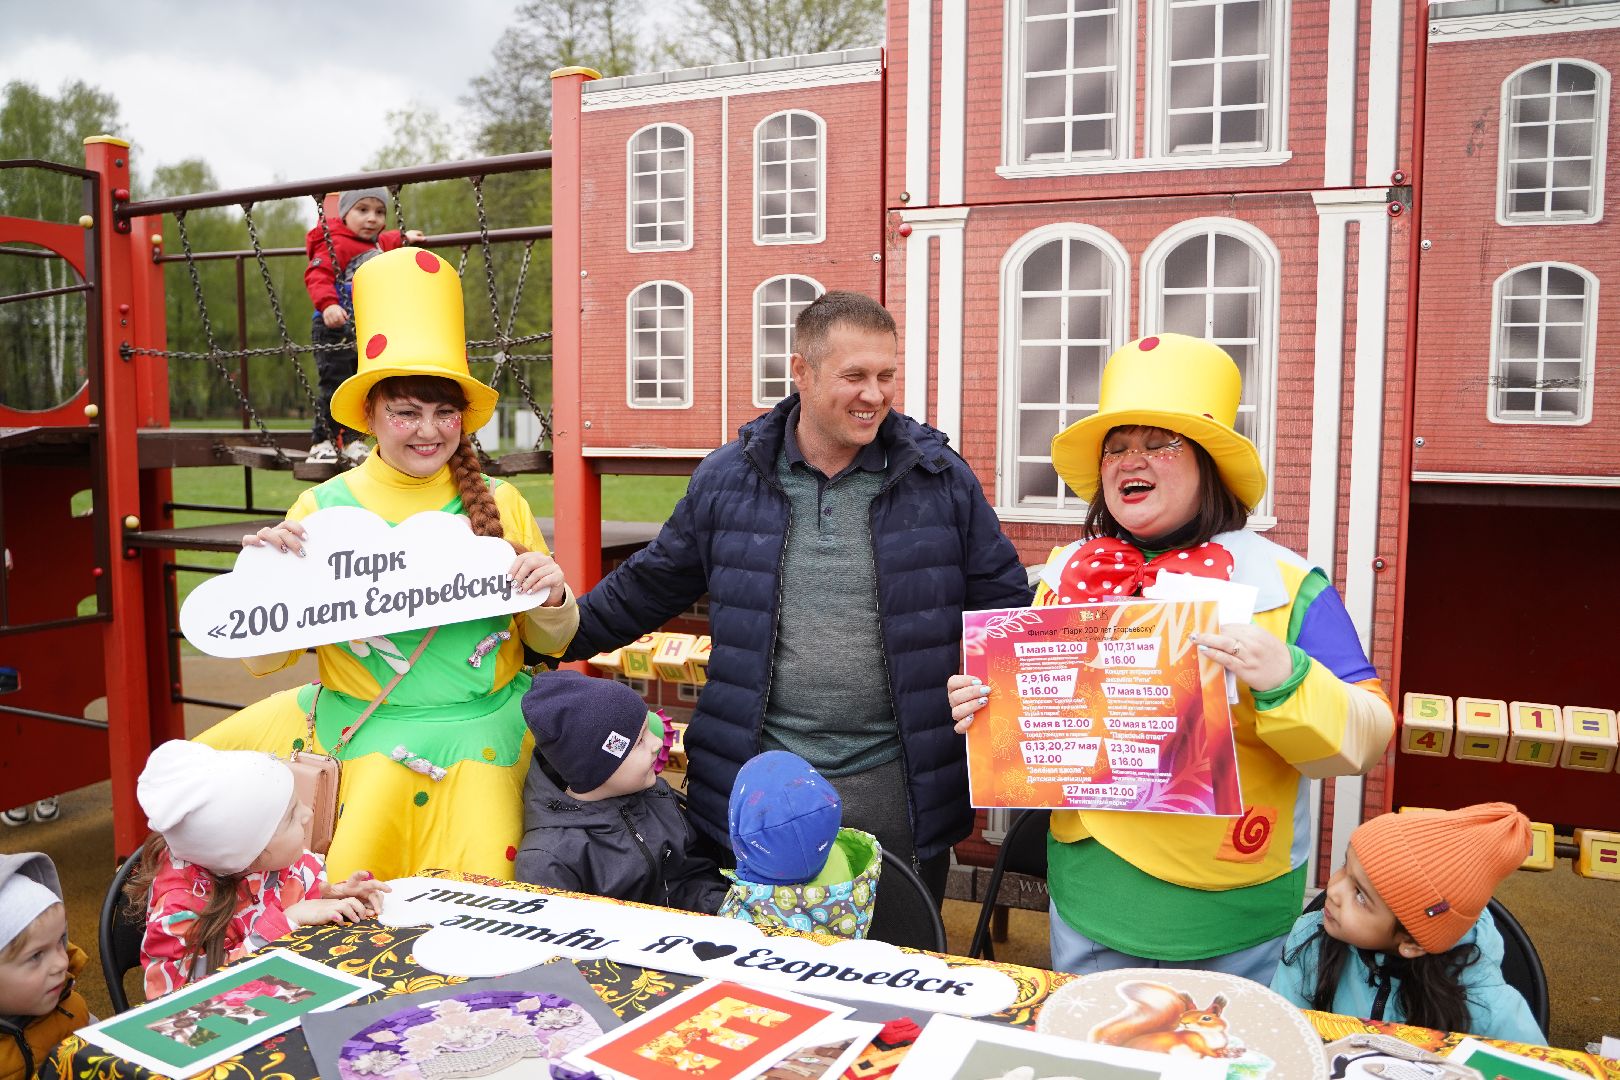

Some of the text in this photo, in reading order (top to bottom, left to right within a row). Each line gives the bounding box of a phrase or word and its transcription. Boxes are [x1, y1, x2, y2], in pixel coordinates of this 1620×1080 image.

[328, 549, 407, 582] Парк
[207, 602, 289, 640] «200
[297, 599, 358, 629] лет
[1084, 626, 1099, 634] 200
[1019, 645, 1025, 654] 1
[1055, 643, 1083, 653] 12.00
[1103, 642, 1154, 653] 10,17,31 мая
[1111, 655, 1136, 664] 16.00
[1021, 674, 1072, 685] 2,9,16 мая
[1022, 686, 1059, 696] в 16.00
[1107, 686, 1116, 695] 17
[1143, 687, 1169, 696] 15.00
[1420, 700, 1439, 717] 5
[1531, 710, 1543, 728] 1
[1024, 719, 1031, 728] 6
[1061, 719, 1090, 728] 12.00
[1109, 718, 1121, 728] 20
[1147, 720, 1174, 730] 12.00
[1025, 741, 1076, 752] 6,13,20,27
[1110, 743, 1156, 754] 23,30 мая
[1416, 731, 1436, 748] 4
[1530, 743, 1542, 759] 1
[1026, 754, 1062, 764] в 12.00
[1118, 757, 1143, 767] 16.00
[1066, 786, 1079, 794] 27
[1109, 786, 1134, 796] 12.00
[405, 888, 549, 914] дети!
[439, 914, 620, 950] лучшие
[642, 935, 975, 996] Я Егорьевск
